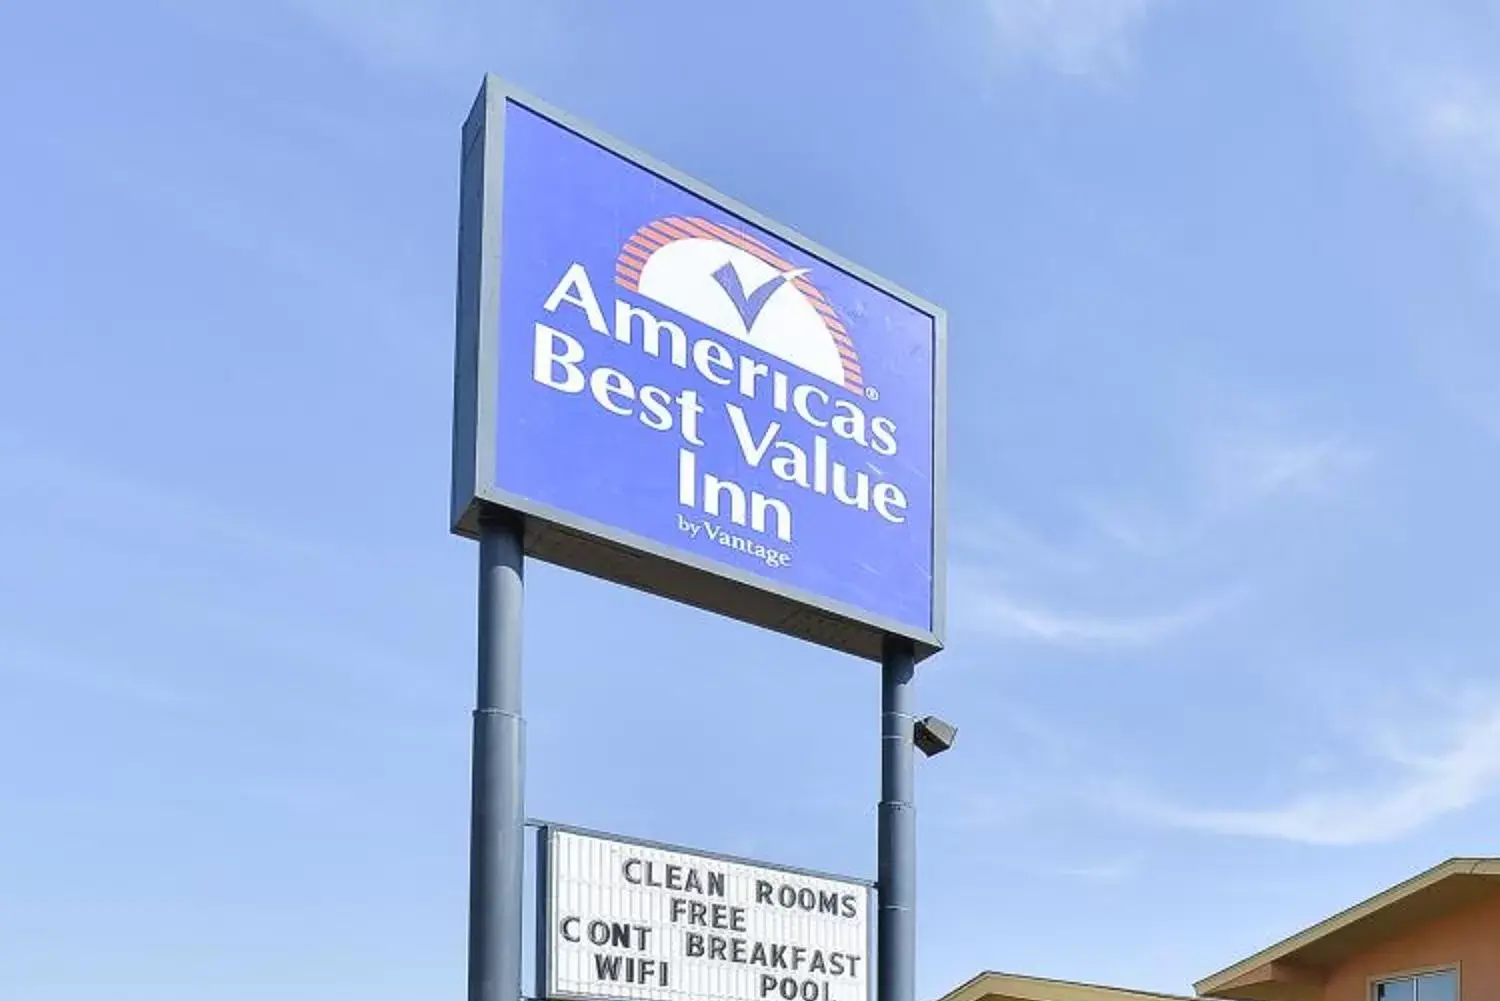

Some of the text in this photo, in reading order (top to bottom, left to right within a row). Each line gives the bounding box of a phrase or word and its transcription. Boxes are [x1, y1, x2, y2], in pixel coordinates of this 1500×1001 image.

[543, 262, 898, 456] Americas
[532, 322, 910, 524] Best Value
[677, 448, 793, 543] Inn
[678, 514, 792, 568] by Vantage
[622, 858, 857, 919] CLEAN ROOMS
[669, 898, 747, 933] FREE
[560, 916, 862, 979] CONT BREAKFAST
[594, 954, 669, 987] WIFI
